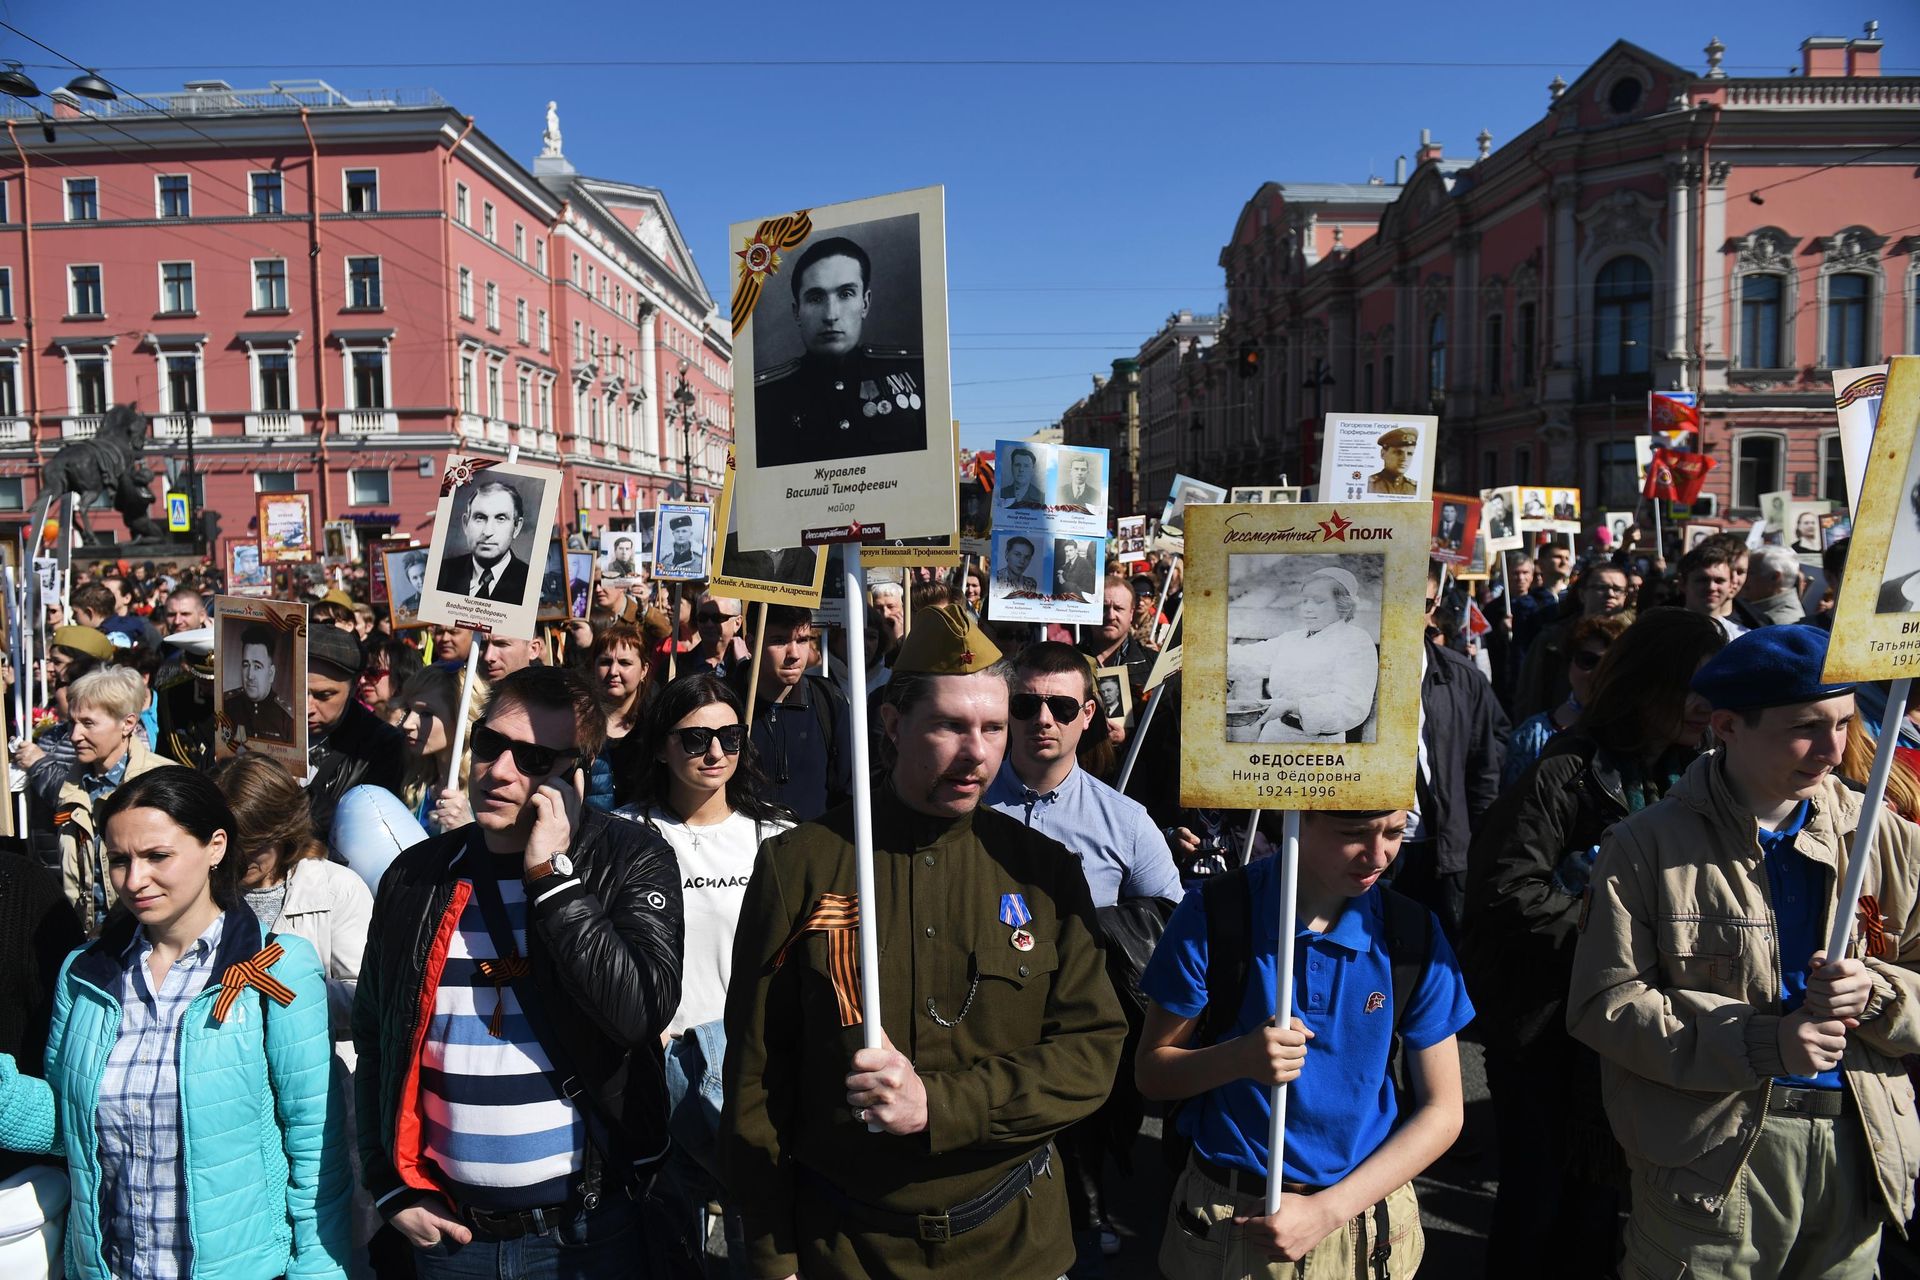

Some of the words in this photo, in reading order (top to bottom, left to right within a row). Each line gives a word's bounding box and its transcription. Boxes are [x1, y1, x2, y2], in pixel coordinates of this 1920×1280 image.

[1340, 422, 1373, 430] Погорелов
[1374, 422, 1399, 430] Георгий
[814, 466, 866, 481] Журавлев
[785, 484, 829, 499] Василий
[832, 479, 898, 495] Тимофеевич
[827, 503, 856, 513] майор
[1223, 512, 1322, 545] бессмертный
[881, 547, 912, 556] Николай
[913, 548, 958, 557] Трофимович
[712, 577, 737, 587] Менёк
[738, 580, 778, 594] Александр
[779, 586, 819, 597] Андреевич
[463, 597, 492, 608] Чистяков
[445, 601, 474, 613] Владимир
[474, 606, 508, 620] Федорович,
[1901, 621, 1920, 634] ВИ
[1870, 640, 1920, 652] Татьяна
[1249, 754, 1345, 768] ФЕДОСЕЕВА
[1232, 769, 1270, 781] Нина
[1276, 770, 1361, 783] Фёдоровна
[1257, 785, 1336, 797] 1924-1996
